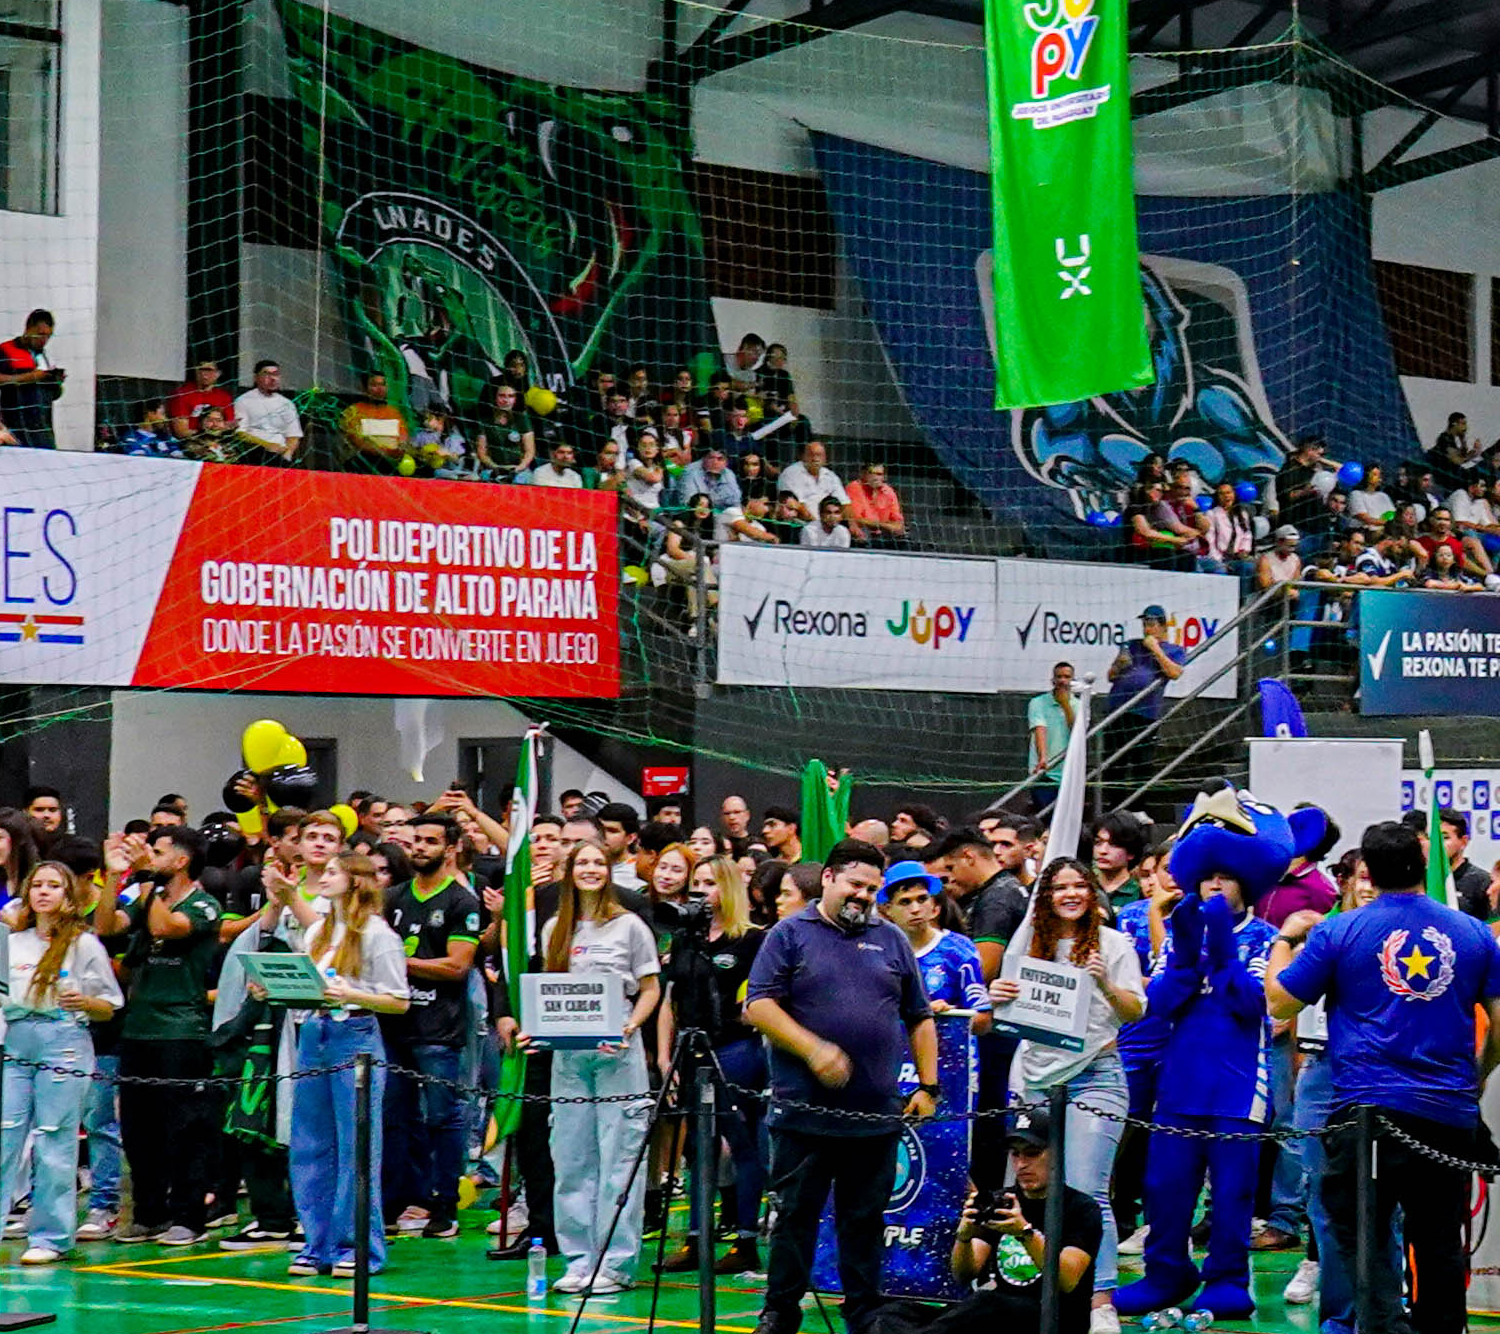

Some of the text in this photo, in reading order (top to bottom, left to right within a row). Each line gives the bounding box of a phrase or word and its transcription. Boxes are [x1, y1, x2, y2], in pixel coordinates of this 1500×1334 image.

[330, 517, 599, 572] POLIDEPORTIVO DE LA
[201, 560, 599, 620] GOBERNACIÓN DE ALTO PARANÁ
[773, 600, 868, 637] Rexona
[1043, 611, 1125, 645] Rexona
[203, 618, 599, 665] DONDE LA PASIÓN SE CONVIERTE EN JUEGO
[1402, 631, 1422, 652] LA
[1425, 628, 1483, 653] PASIÓN
[1402, 656, 1467, 678] REXONA
[1469, 657, 1487, 678] TE
[544, 1000, 562, 1012] SAN
[1031, 987, 1061, 1005] LA PAZ
